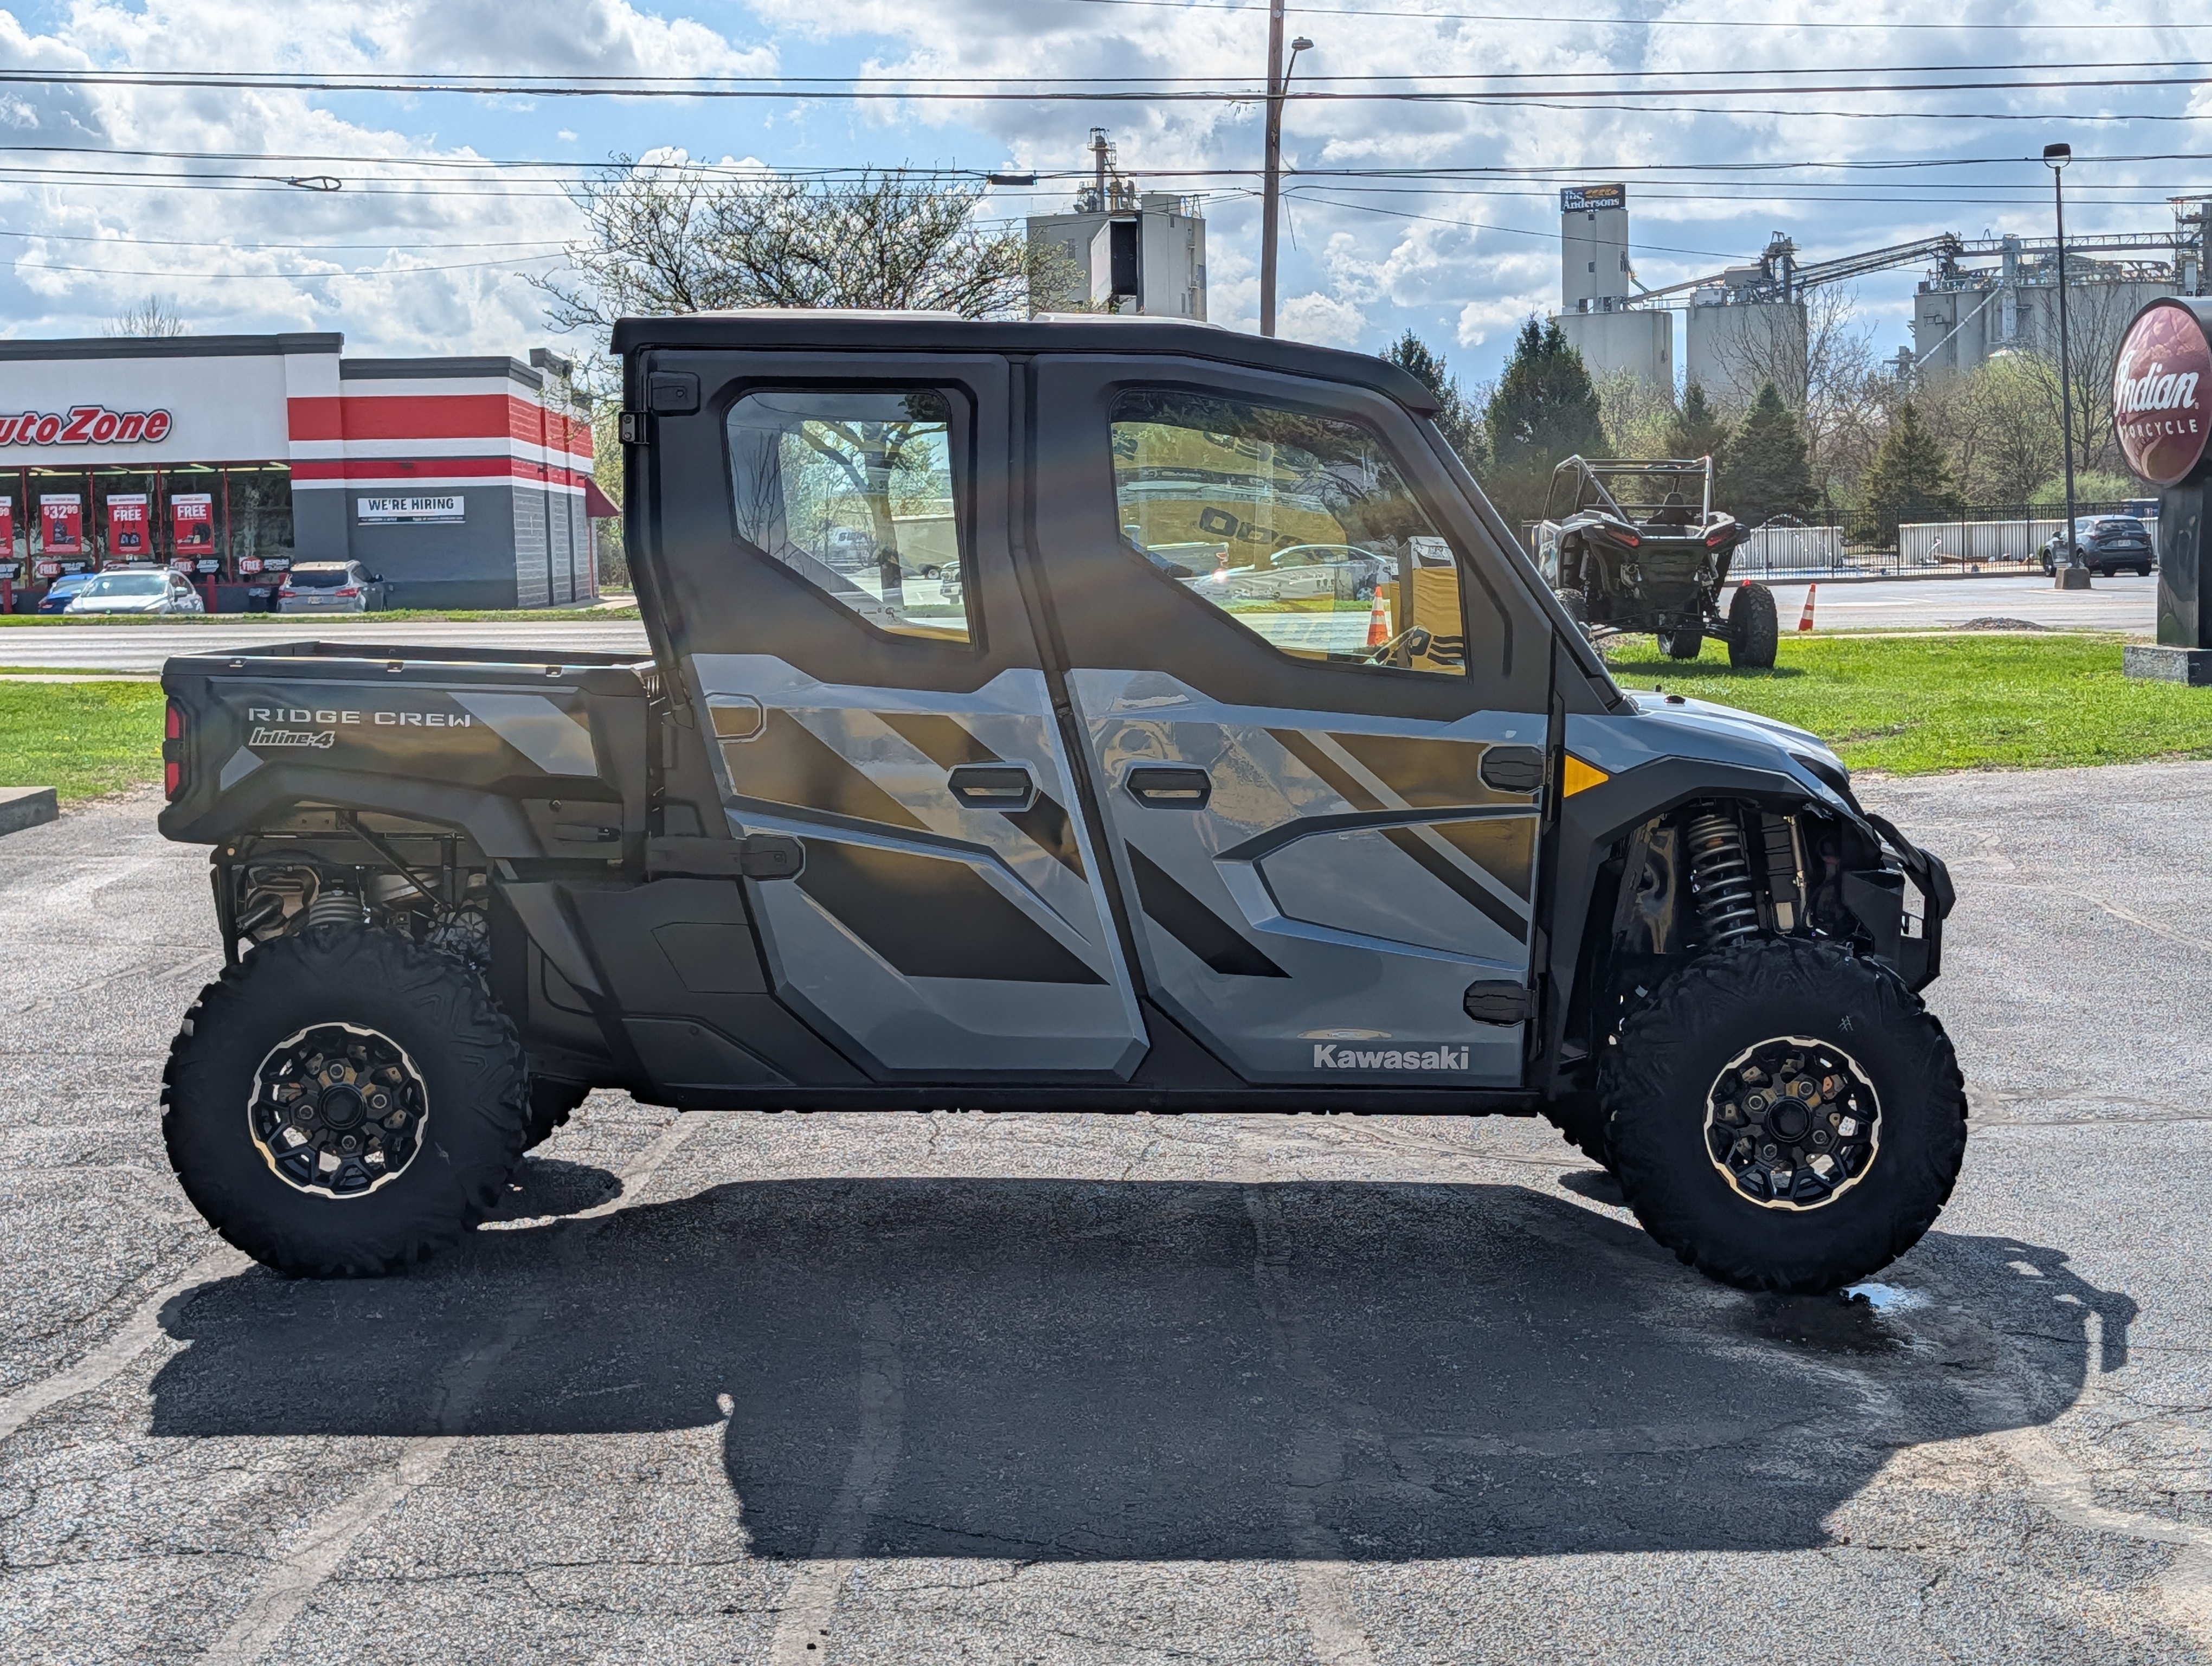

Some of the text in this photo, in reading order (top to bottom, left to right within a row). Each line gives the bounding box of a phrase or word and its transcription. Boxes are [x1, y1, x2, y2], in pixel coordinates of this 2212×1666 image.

[1564, 190, 1583, 200] The
[1564, 198, 1619, 209] Andersons
[2114, 350, 2199, 416] Indian
[0, 407, 170, 444] utoZone
[177, 505, 207, 517] FREE
[368, 498, 454, 511] WE'RE HIRING
[113, 509, 142, 522] FREE
[249, 708, 471, 727] RIDGE CREW
[1314, 1045, 1469, 1069] Kawasaki
